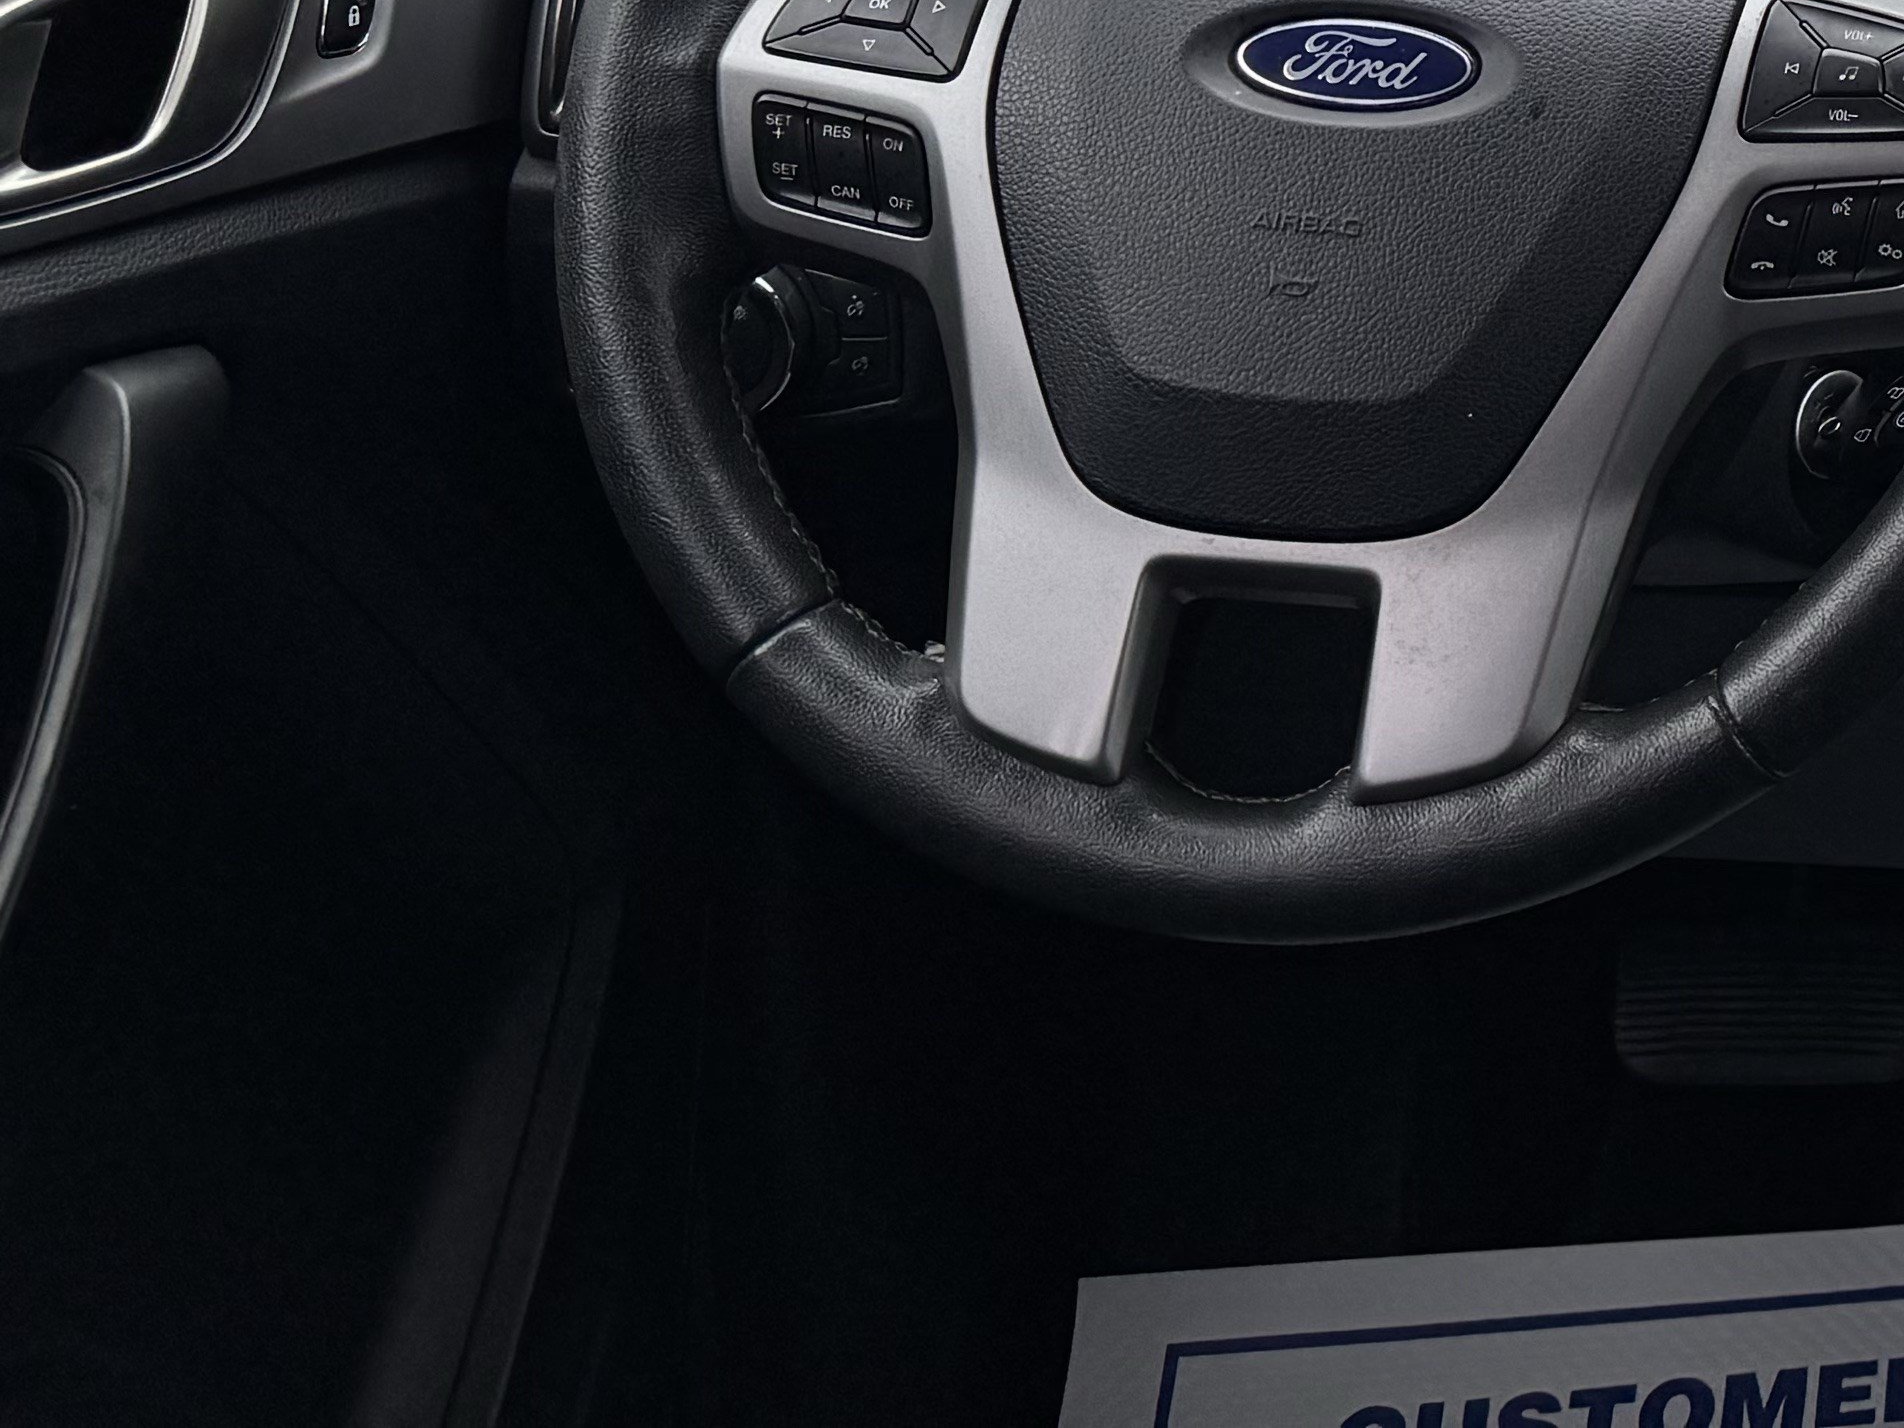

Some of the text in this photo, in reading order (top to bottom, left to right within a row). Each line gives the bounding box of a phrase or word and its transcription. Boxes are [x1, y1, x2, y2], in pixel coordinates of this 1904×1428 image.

[1282, 30, 1428, 90] Ford
[766, 114, 793, 127] SET
[822, 125, 852, 139] RES
[882, 138, 904, 152] ON
[771, 162, 799, 176] SET
[831, 185, 860, 200] CAN
[888, 197, 914, 212] OFF
